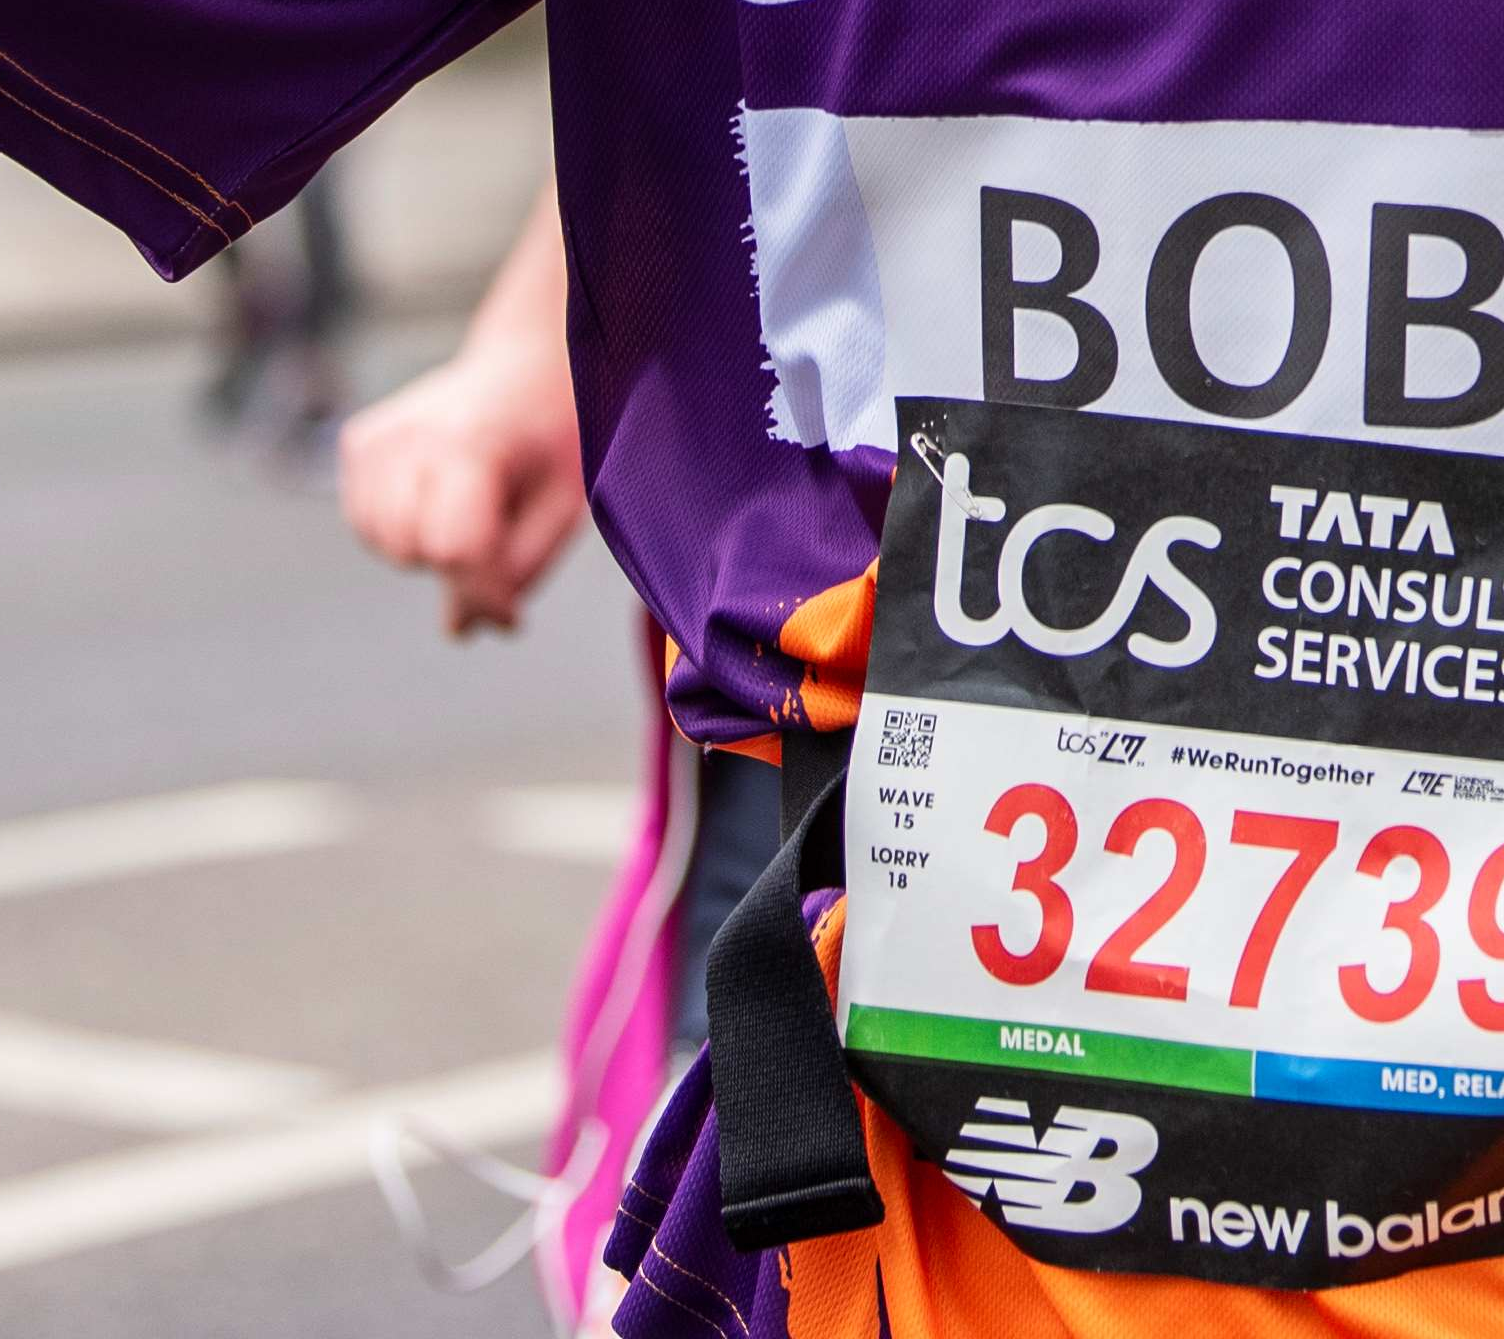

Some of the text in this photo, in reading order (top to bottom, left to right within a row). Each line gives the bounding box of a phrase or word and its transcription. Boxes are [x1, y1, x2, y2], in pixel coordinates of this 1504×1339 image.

[1269, 484, 1454, 557] TATA
[933, 451, 1222, 668] tcs
[1056, 725, 1097, 756] tcs
[1170, 745, 1375, 787] #WeRunTogether
[878, 787, 935, 809] WAVE
[892, 811, 915, 831] 15
[870, 845, 930, 868] LORRY
[887, 870, 909, 890] 18
[999, 1025, 1086, 1058] MEDAL
[1380, 1065, 1445, 1099] MED,
[1168, 1195, 1312, 1257] new
